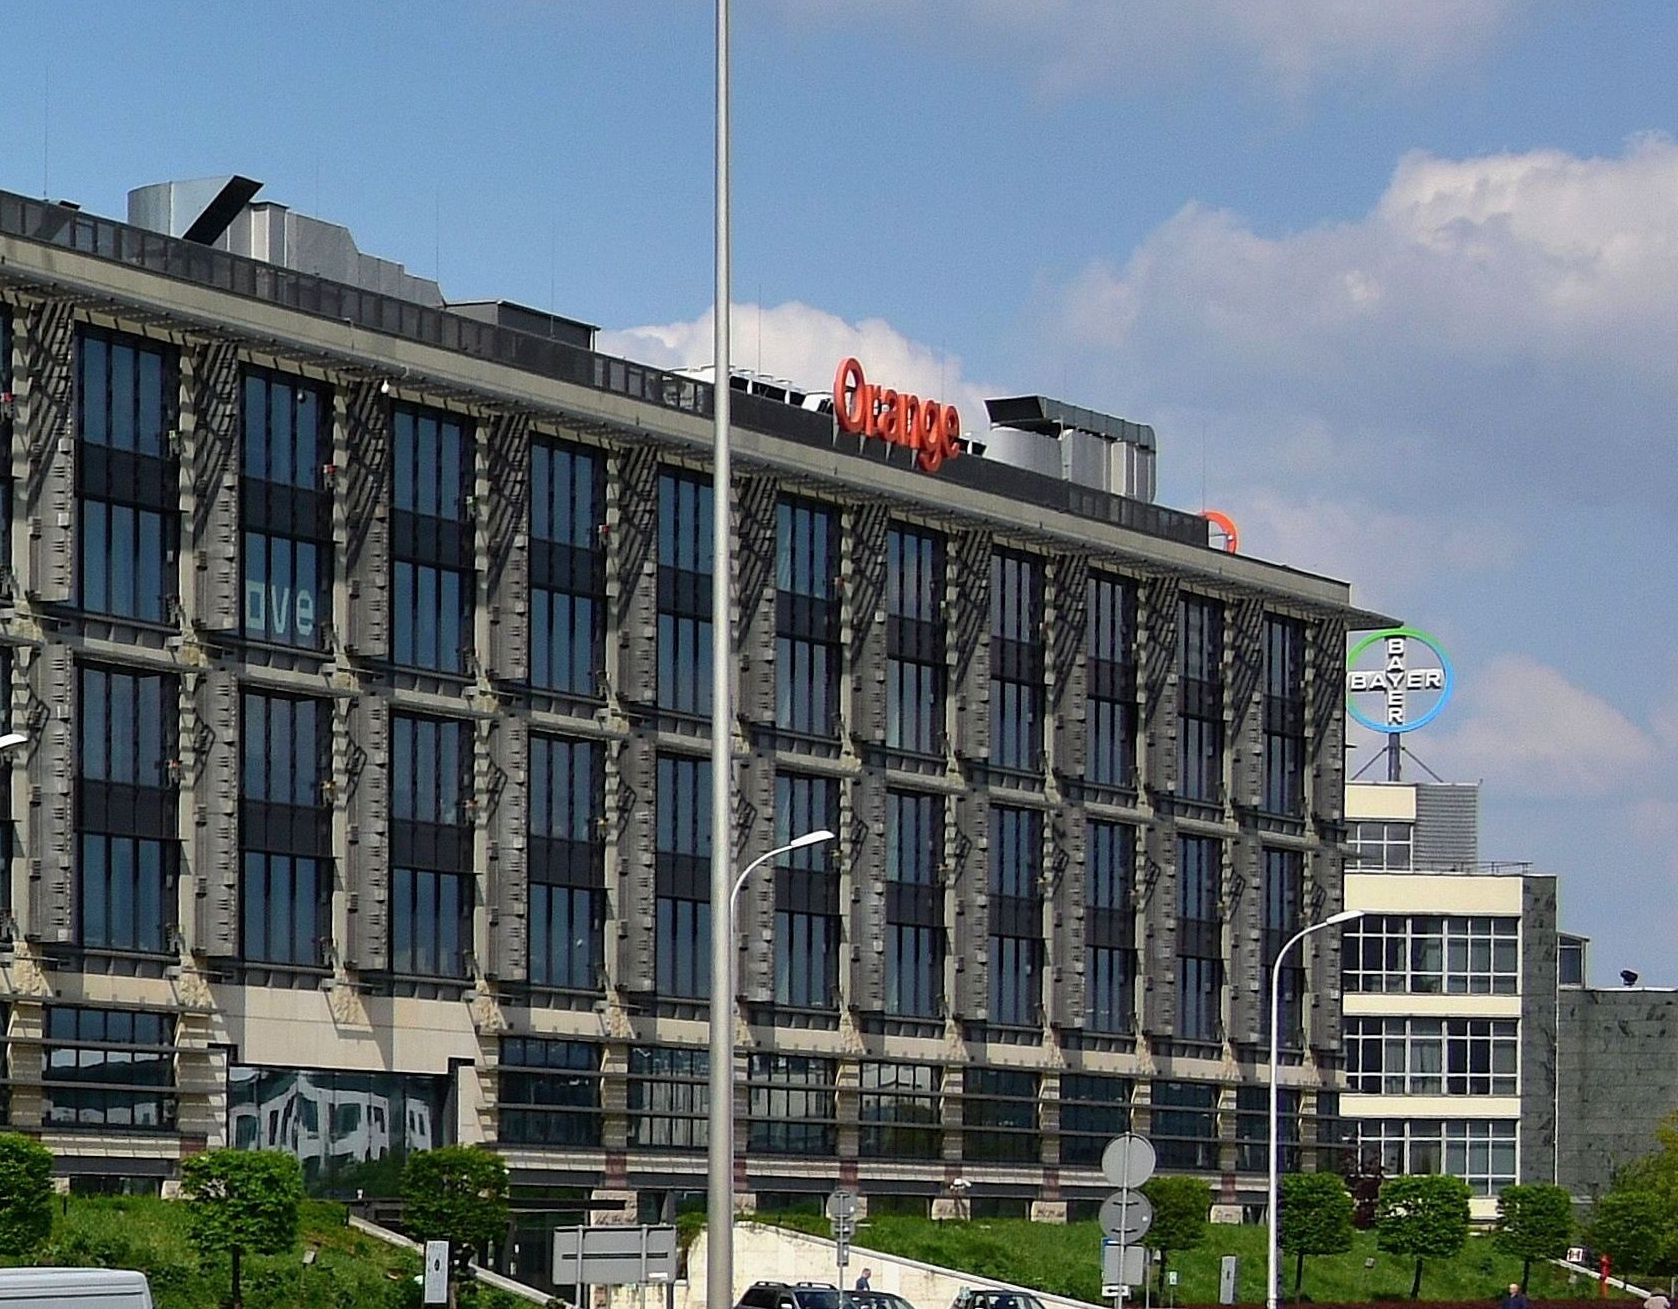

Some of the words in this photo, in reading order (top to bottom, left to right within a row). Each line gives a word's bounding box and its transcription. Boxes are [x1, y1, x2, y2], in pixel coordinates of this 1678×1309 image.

[833, 357, 961, 473] Orange
[1350, 671, 1441, 692] BAYER
[1387, 638, 1405, 725] BAYER
